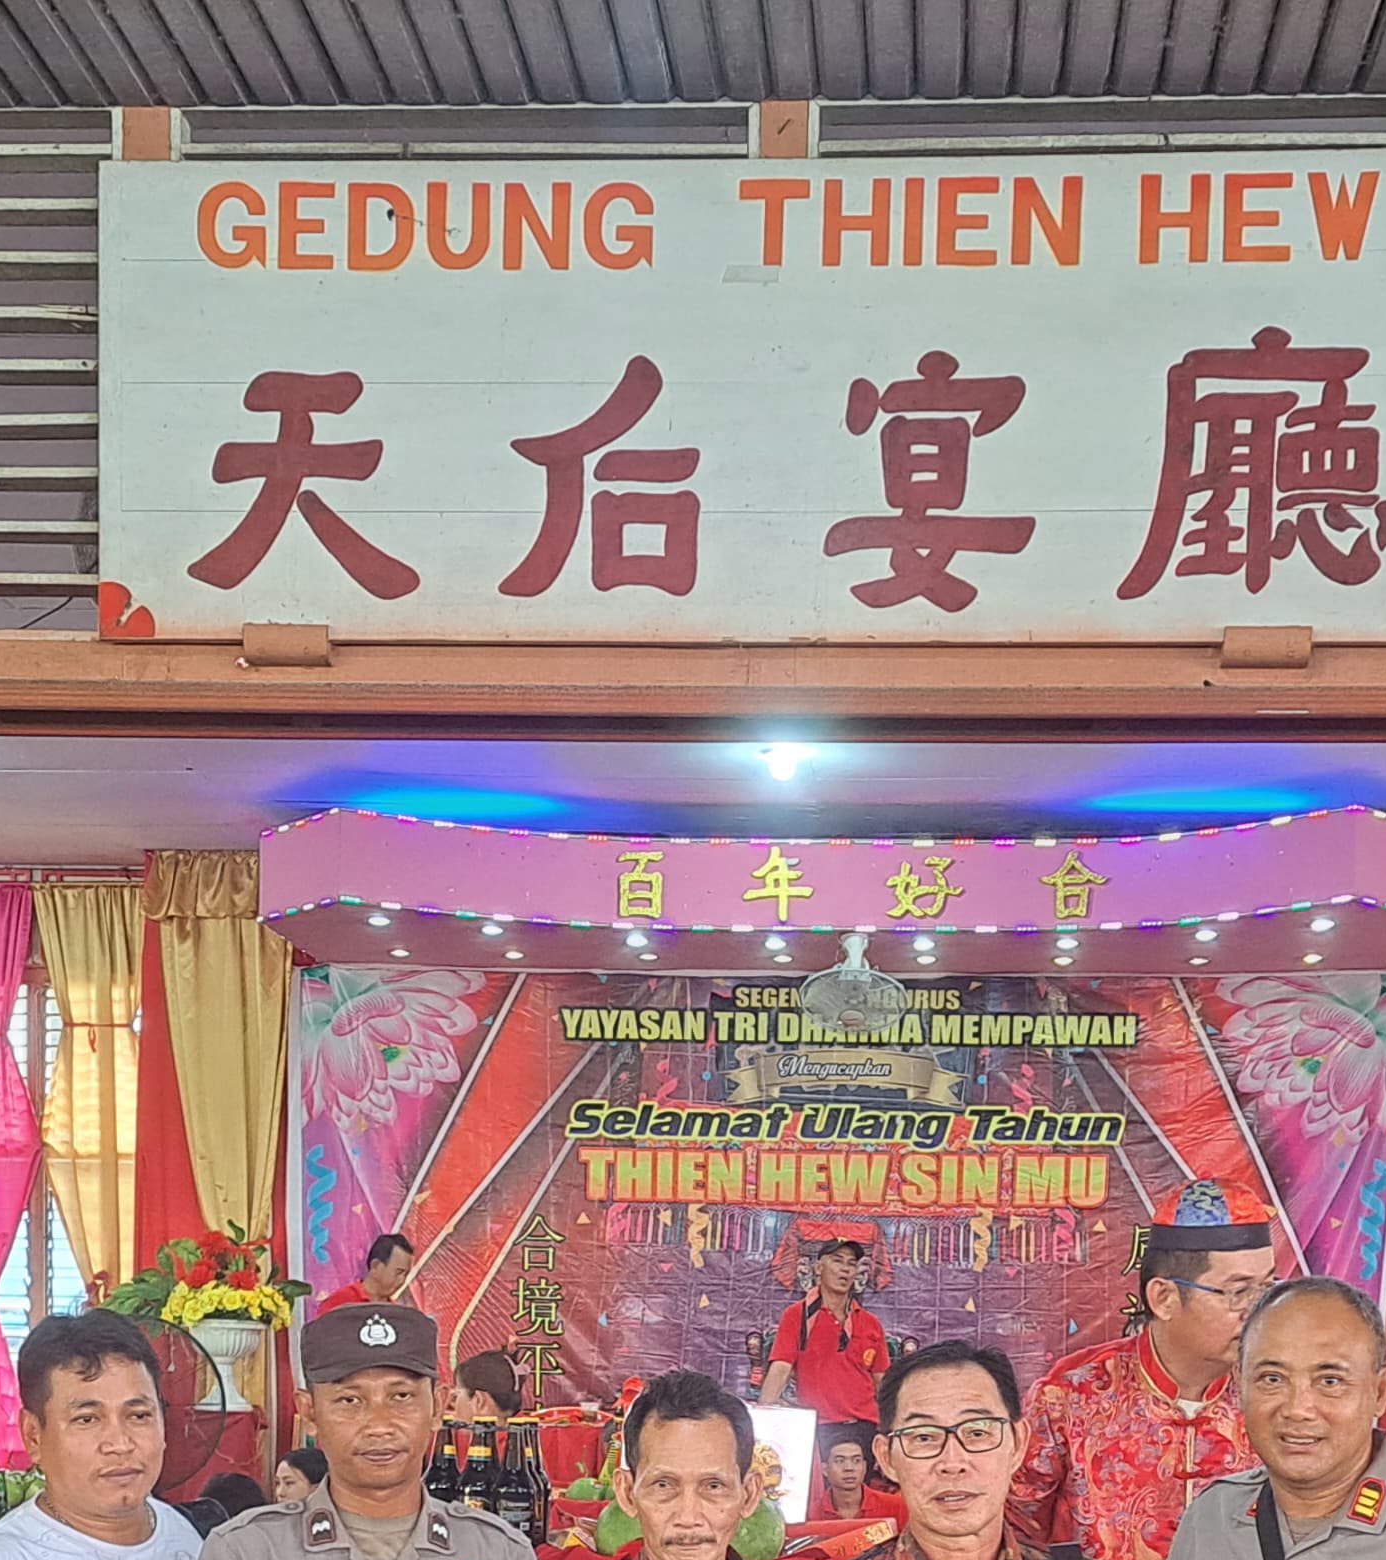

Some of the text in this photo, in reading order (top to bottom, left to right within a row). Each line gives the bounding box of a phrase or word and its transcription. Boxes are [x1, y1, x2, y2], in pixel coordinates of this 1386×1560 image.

[196, 171, 1381, 271] GEDUNG THIEN HEW
[617, 846, 1109, 922] 百年好合
[562, 1009, 705, 1041] YAYASAN
[714, 1011, 768, 1043] TRI
[931, 1013, 1137, 1046] MEMPAWAH
[778, 1055, 891, 1080] Mengucapkan
[566, 1101, 1129, 1151] Selamat Ulang Tahun
[579, 1146, 1110, 1209] THIEN HEW SIN MU
[512, 1215, 566, 1413] 合境平
